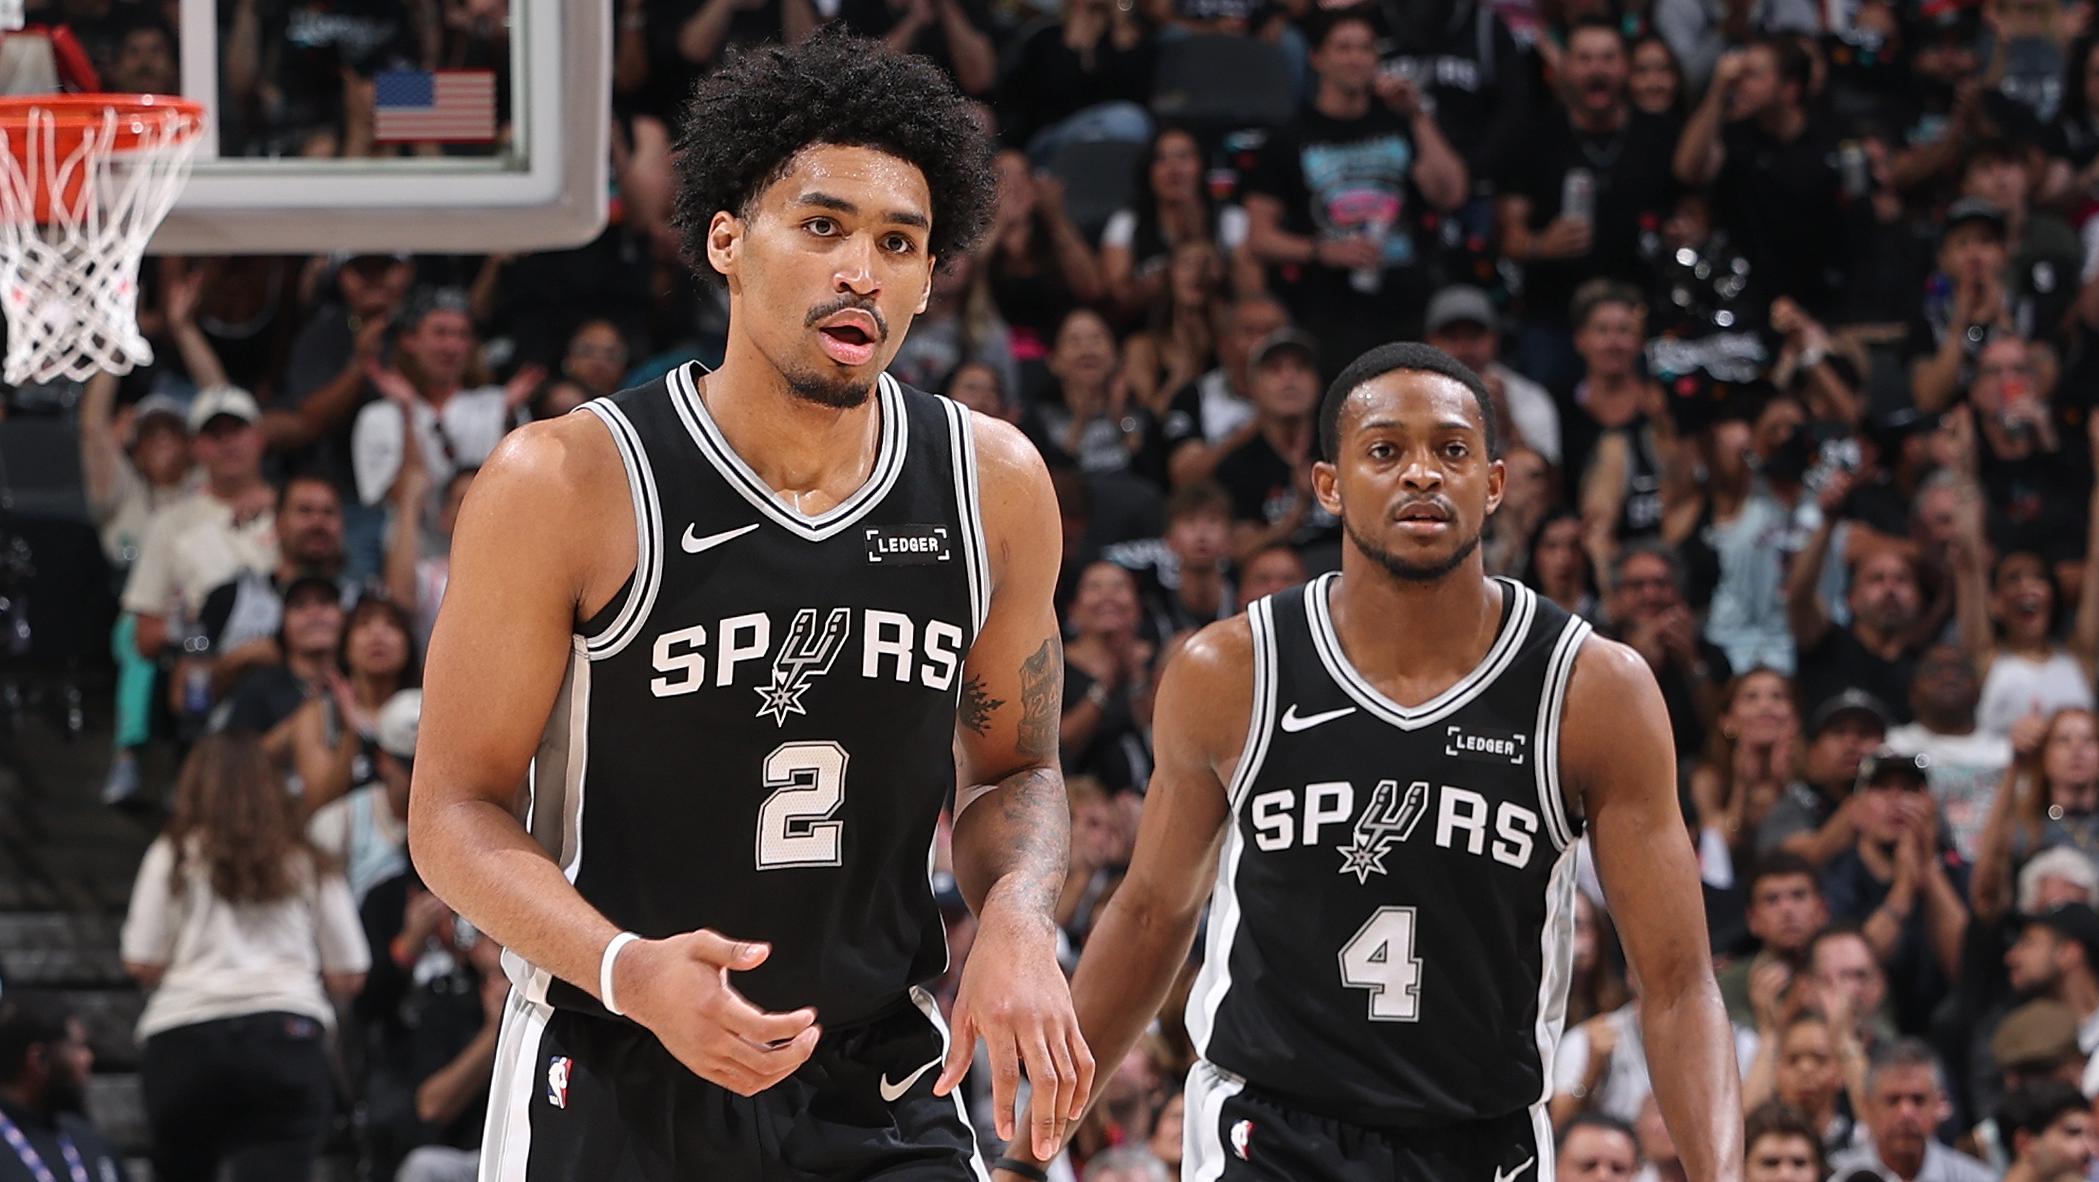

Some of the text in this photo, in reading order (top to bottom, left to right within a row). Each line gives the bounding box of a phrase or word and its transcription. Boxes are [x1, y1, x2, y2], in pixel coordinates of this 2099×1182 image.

[878, 537, 939, 553] LEDGER
[650, 607, 963, 727] SPURS
[1456, 734, 1515, 756] LEDGER
[755, 740, 850, 871] 2
[1251, 779, 1539, 885] SPURS
[1337, 905, 1423, 1023] 4
